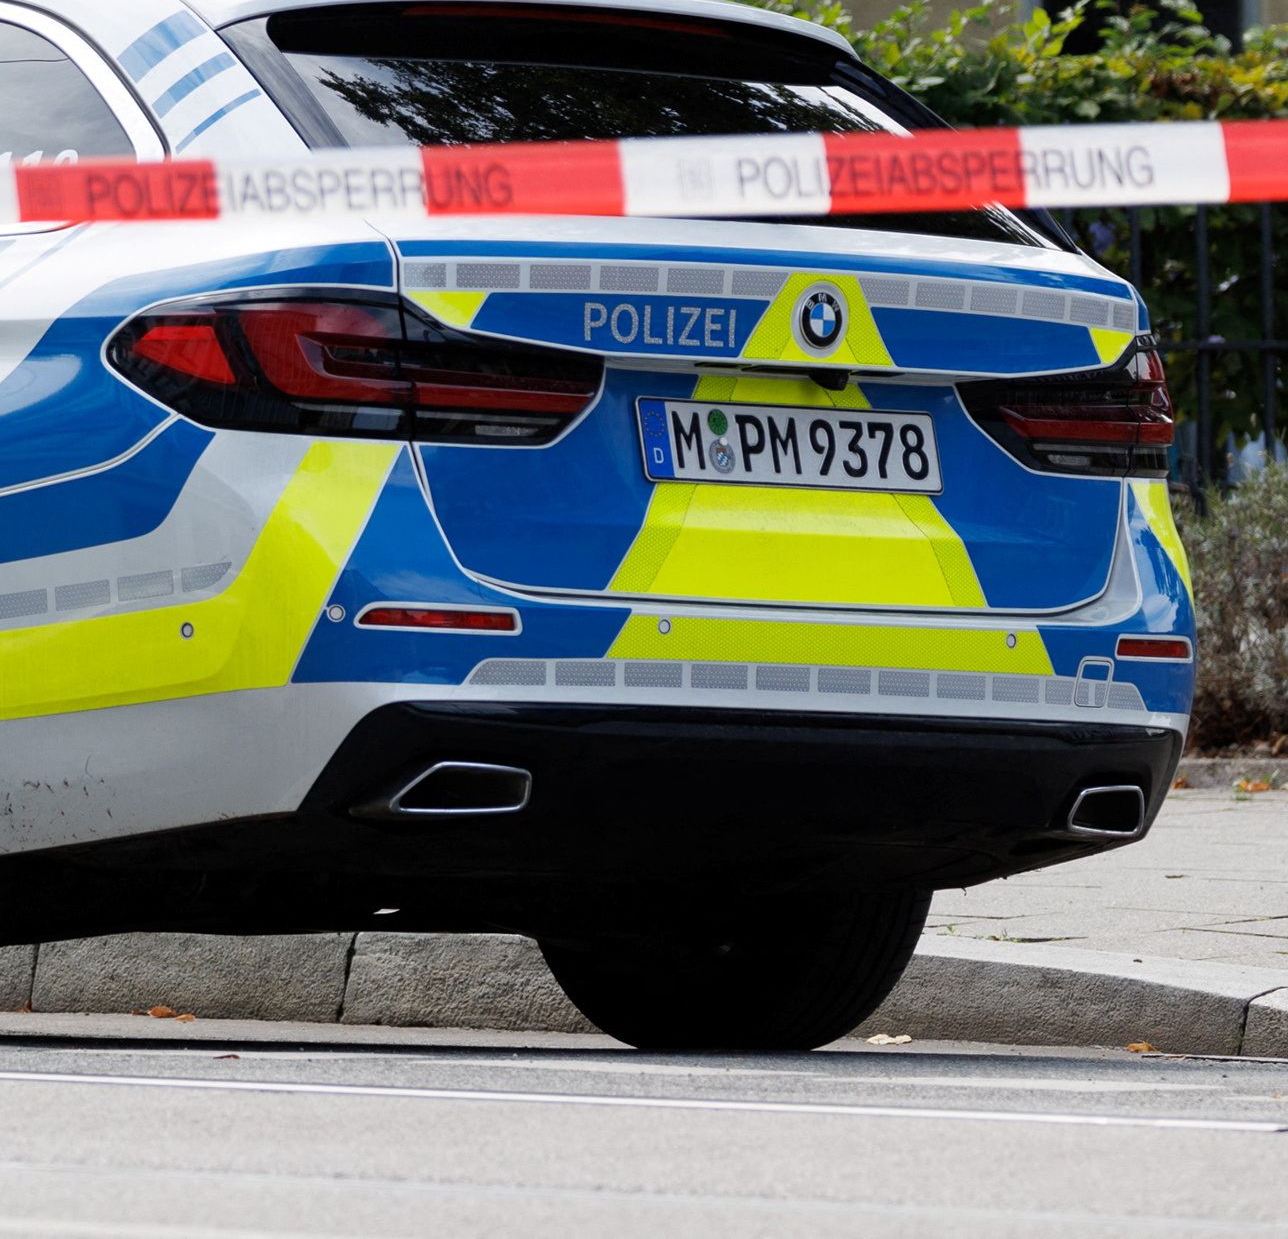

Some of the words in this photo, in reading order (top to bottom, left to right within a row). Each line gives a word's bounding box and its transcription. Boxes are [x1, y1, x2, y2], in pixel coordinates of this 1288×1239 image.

[86, 161, 514, 216] POLIZEIABSPERRUNG
[737, 144, 1155, 199] POLIZEIABSPERRUNG
[583, 301, 737, 348] POLIZEI
[804, 292, 841, 312] BMW
[652, 446, 665, 464] D
[671, 410, 707, 470] M
